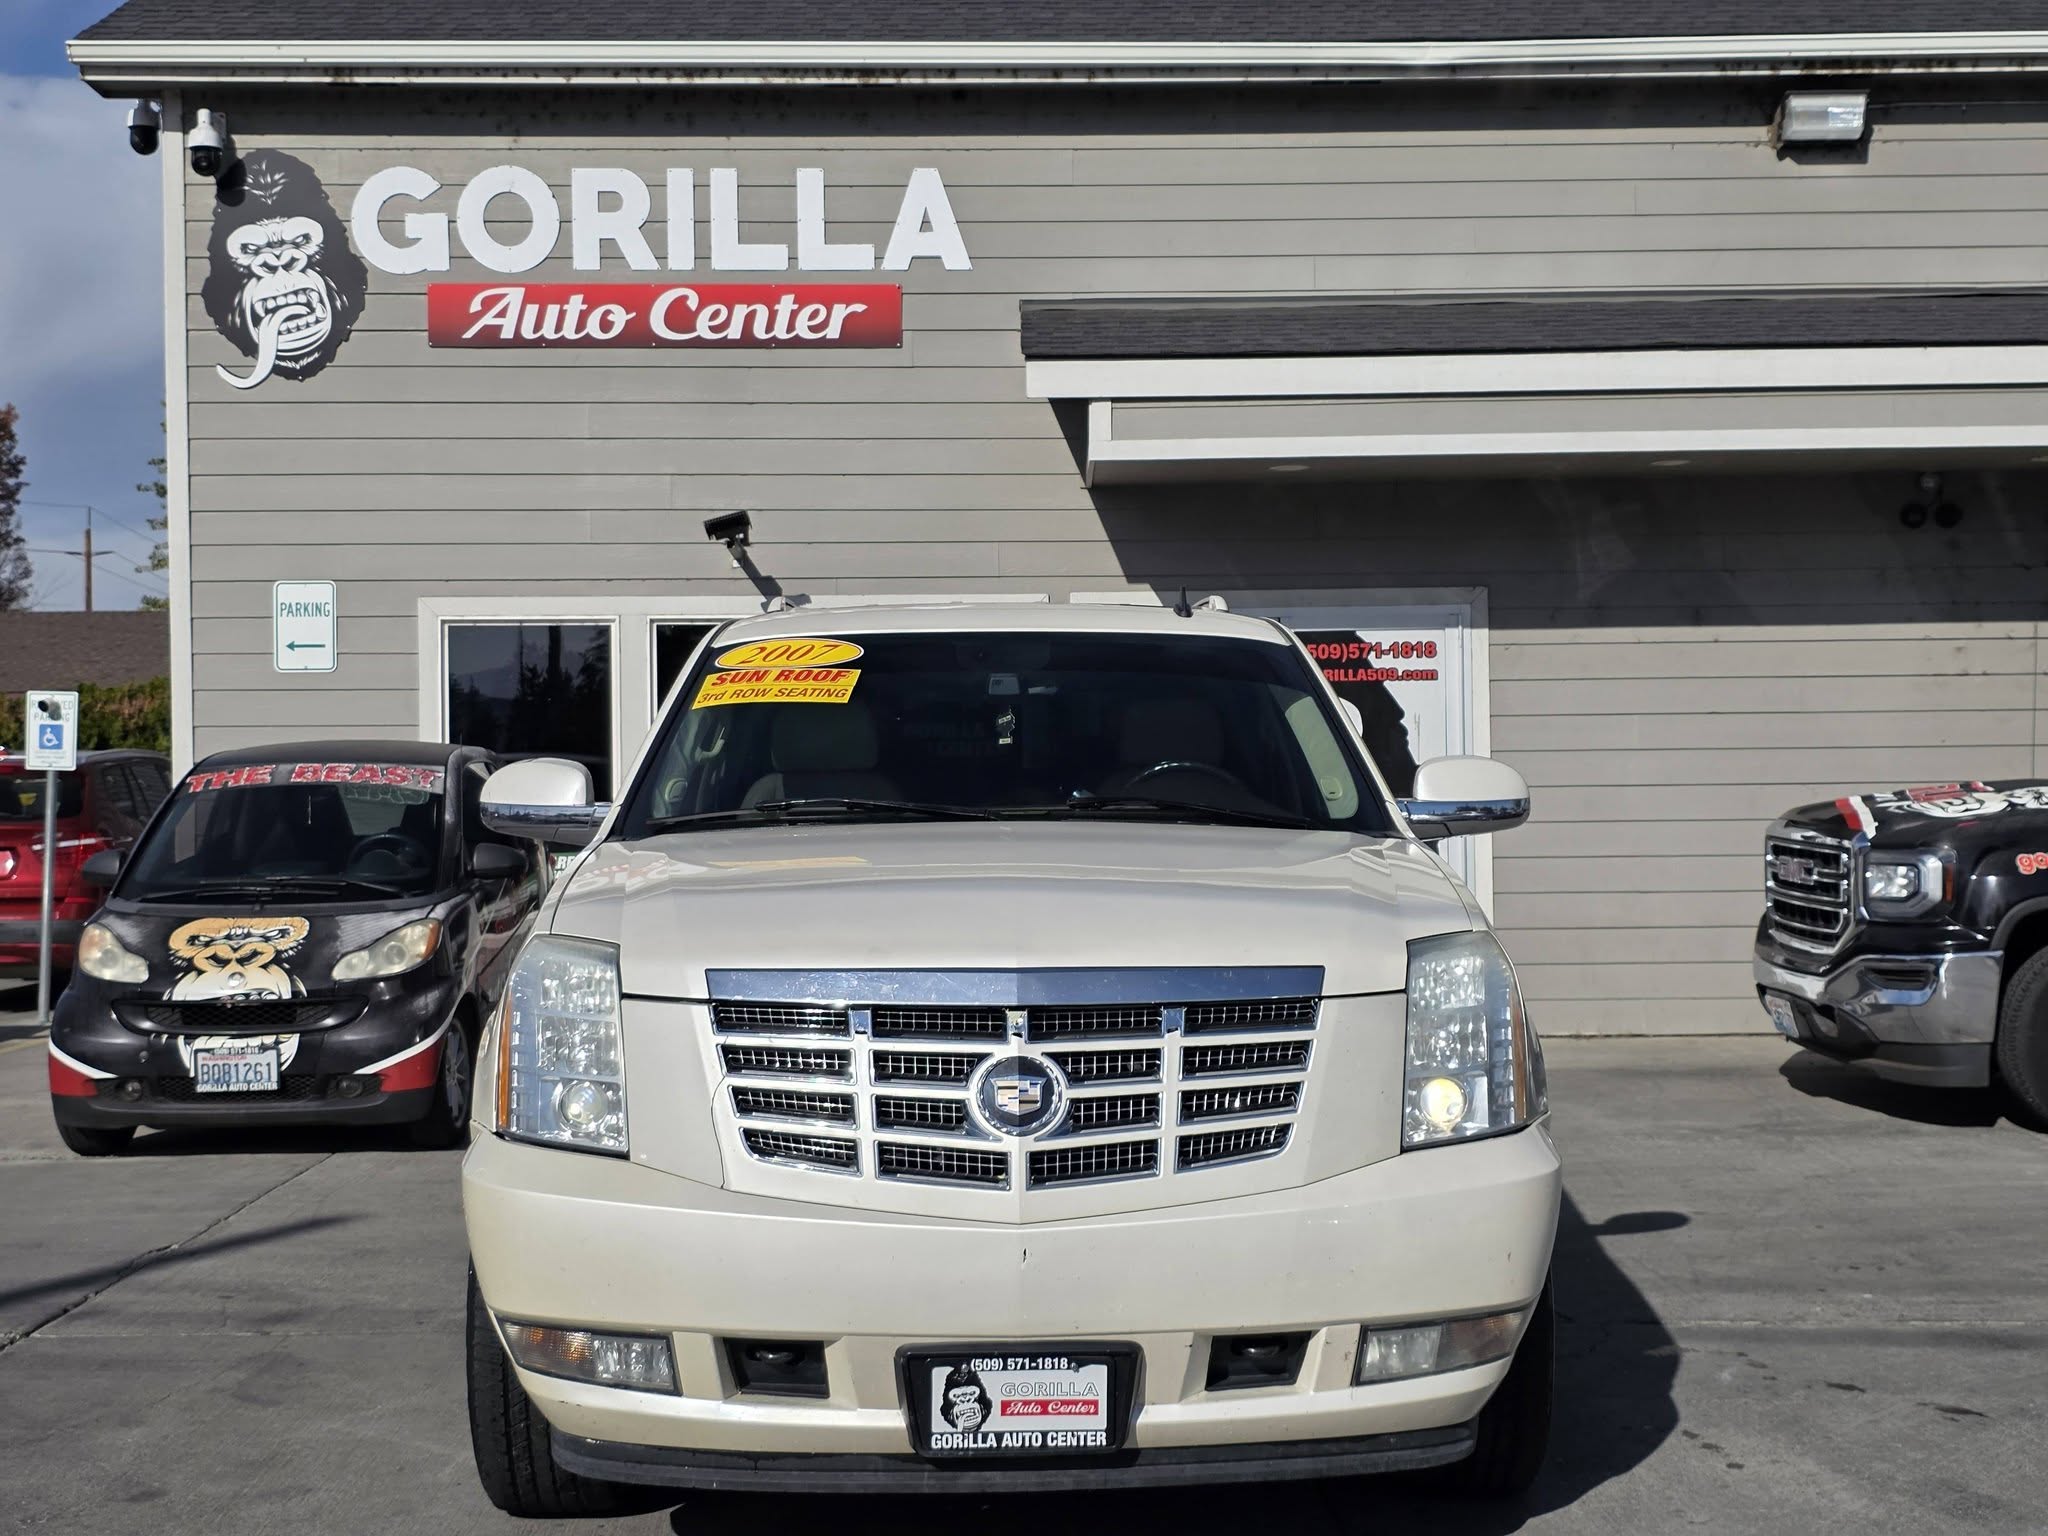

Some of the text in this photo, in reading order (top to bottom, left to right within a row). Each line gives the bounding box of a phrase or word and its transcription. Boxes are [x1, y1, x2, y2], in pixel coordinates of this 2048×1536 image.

[350, 165, 973, 274] GORILLA
[463, 287, 868, 341] Auto Center
[280, 602, 330, 617] PARKING
[736, 645, 842, 665] 2007
[711, 669, 852, 687] SUN ROOF
[697, 687, 847, 704] 3rd ROW SEATING
[186, 763, 444, 793] THE BEAST
[201, 1062, 271, 1083] BQB1261
[229, 1081, 248, 1091] AUTO
[249, 1080, 278, 1090] CENTER
[970, 1357, 1069, 1371] (509) 571-1818
[1000, 1382, 1099, 1397] GORILLA
[1005, 1401, 1097, 1415] Auto Center
[931, 1431, 1107, 1449] GORILLA AUTO CENTER
